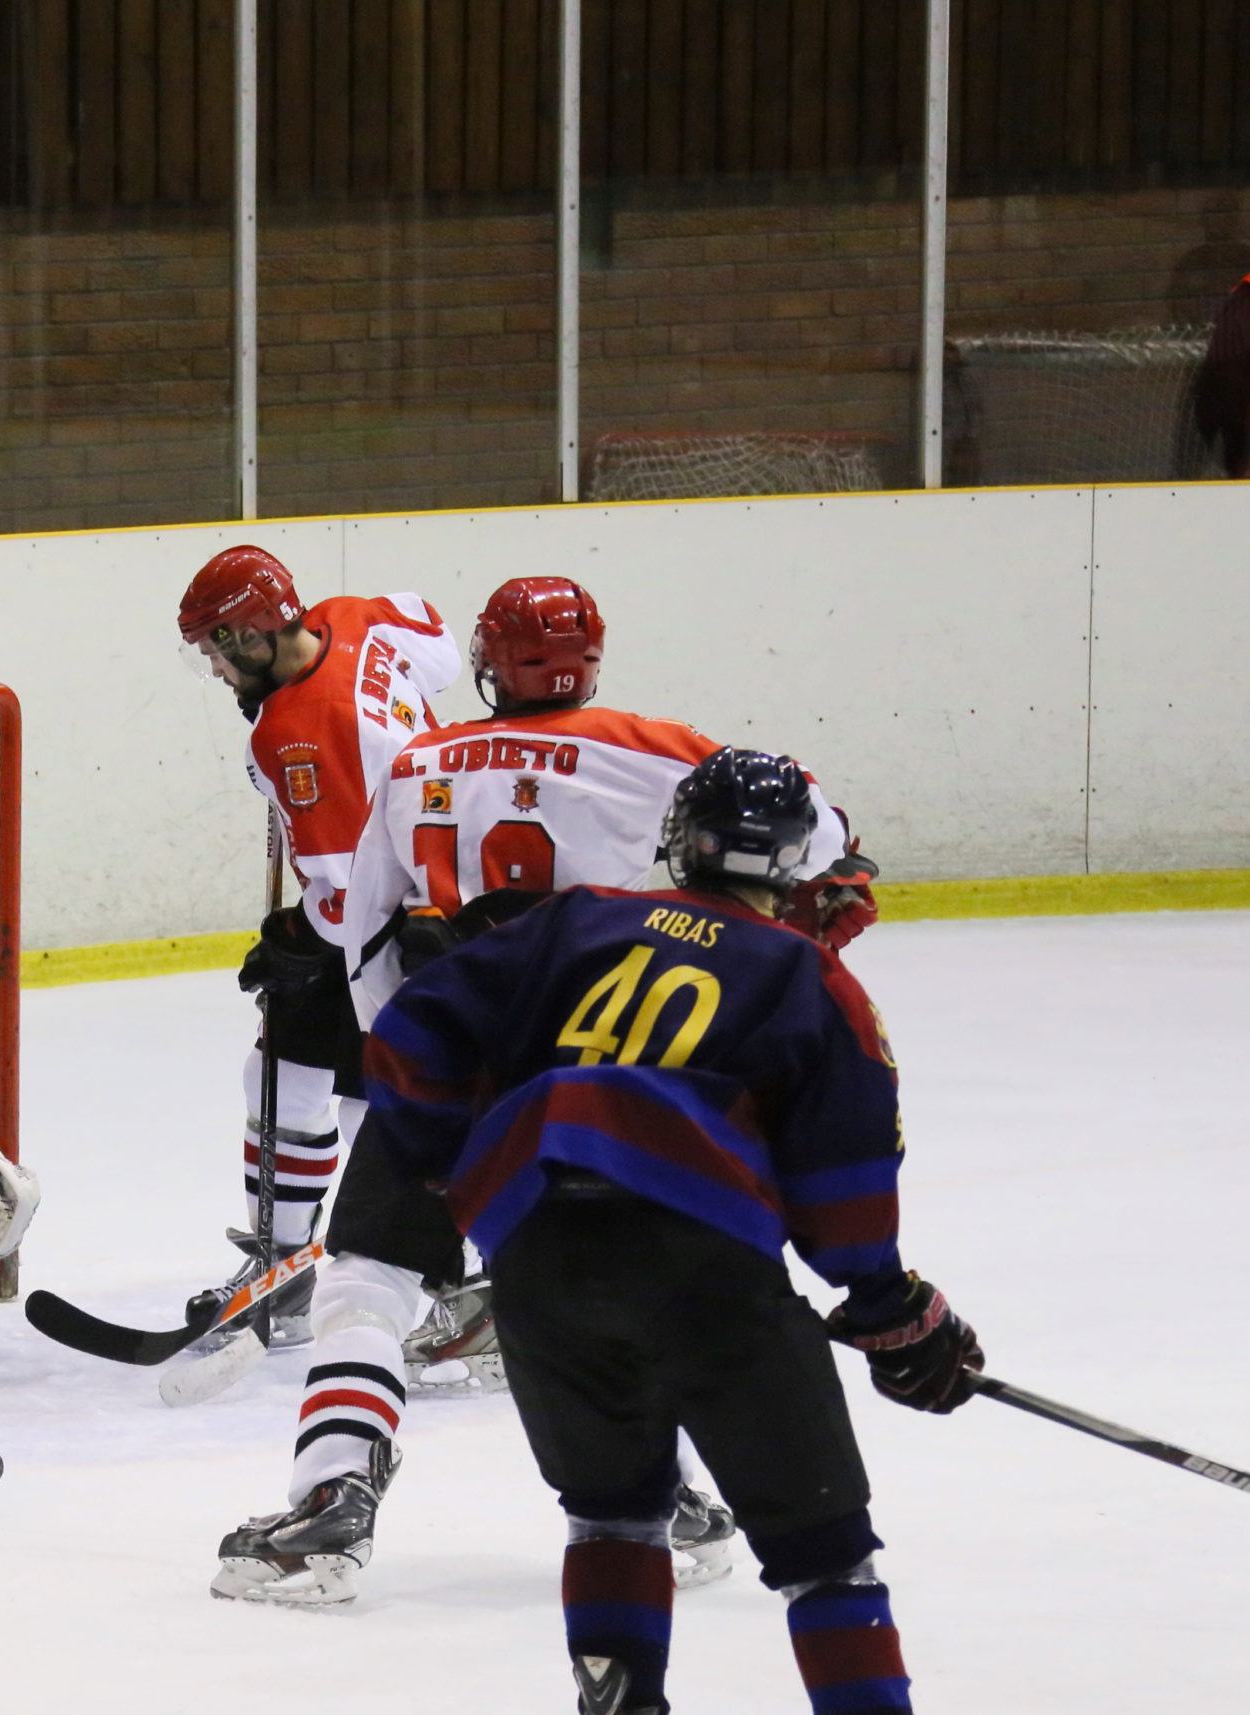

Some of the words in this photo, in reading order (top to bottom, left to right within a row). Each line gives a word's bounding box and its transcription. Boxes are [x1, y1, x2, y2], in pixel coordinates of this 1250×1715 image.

[552, 674, 575, 693] 19
[439, 738, 580, 776] UBIETO
[643, 907, 725, 948] RIBAS
[556, 944, 722, 1068] 40
